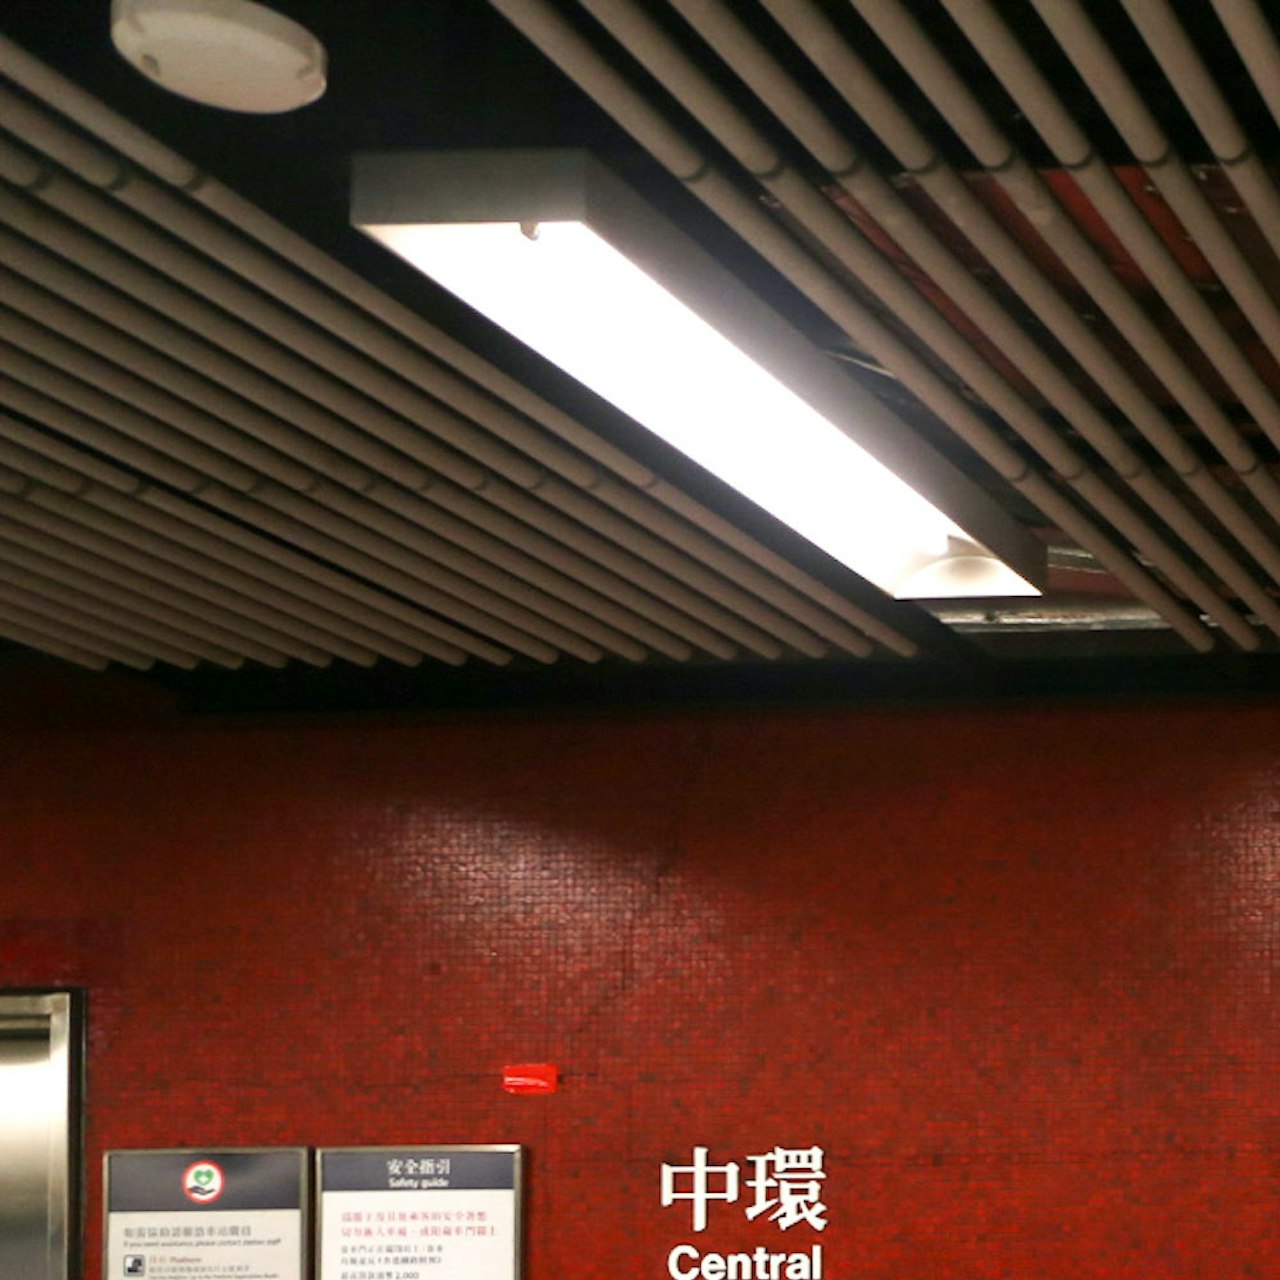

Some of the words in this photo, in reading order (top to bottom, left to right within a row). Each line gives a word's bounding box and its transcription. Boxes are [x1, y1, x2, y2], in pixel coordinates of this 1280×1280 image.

[387, 1158, 450, 1175] 安全指引
[389, 1177, 418, 1189] Safety
[421, 1177, 449, 1189] guide
[660, 1145, 829, 1232] 中環
